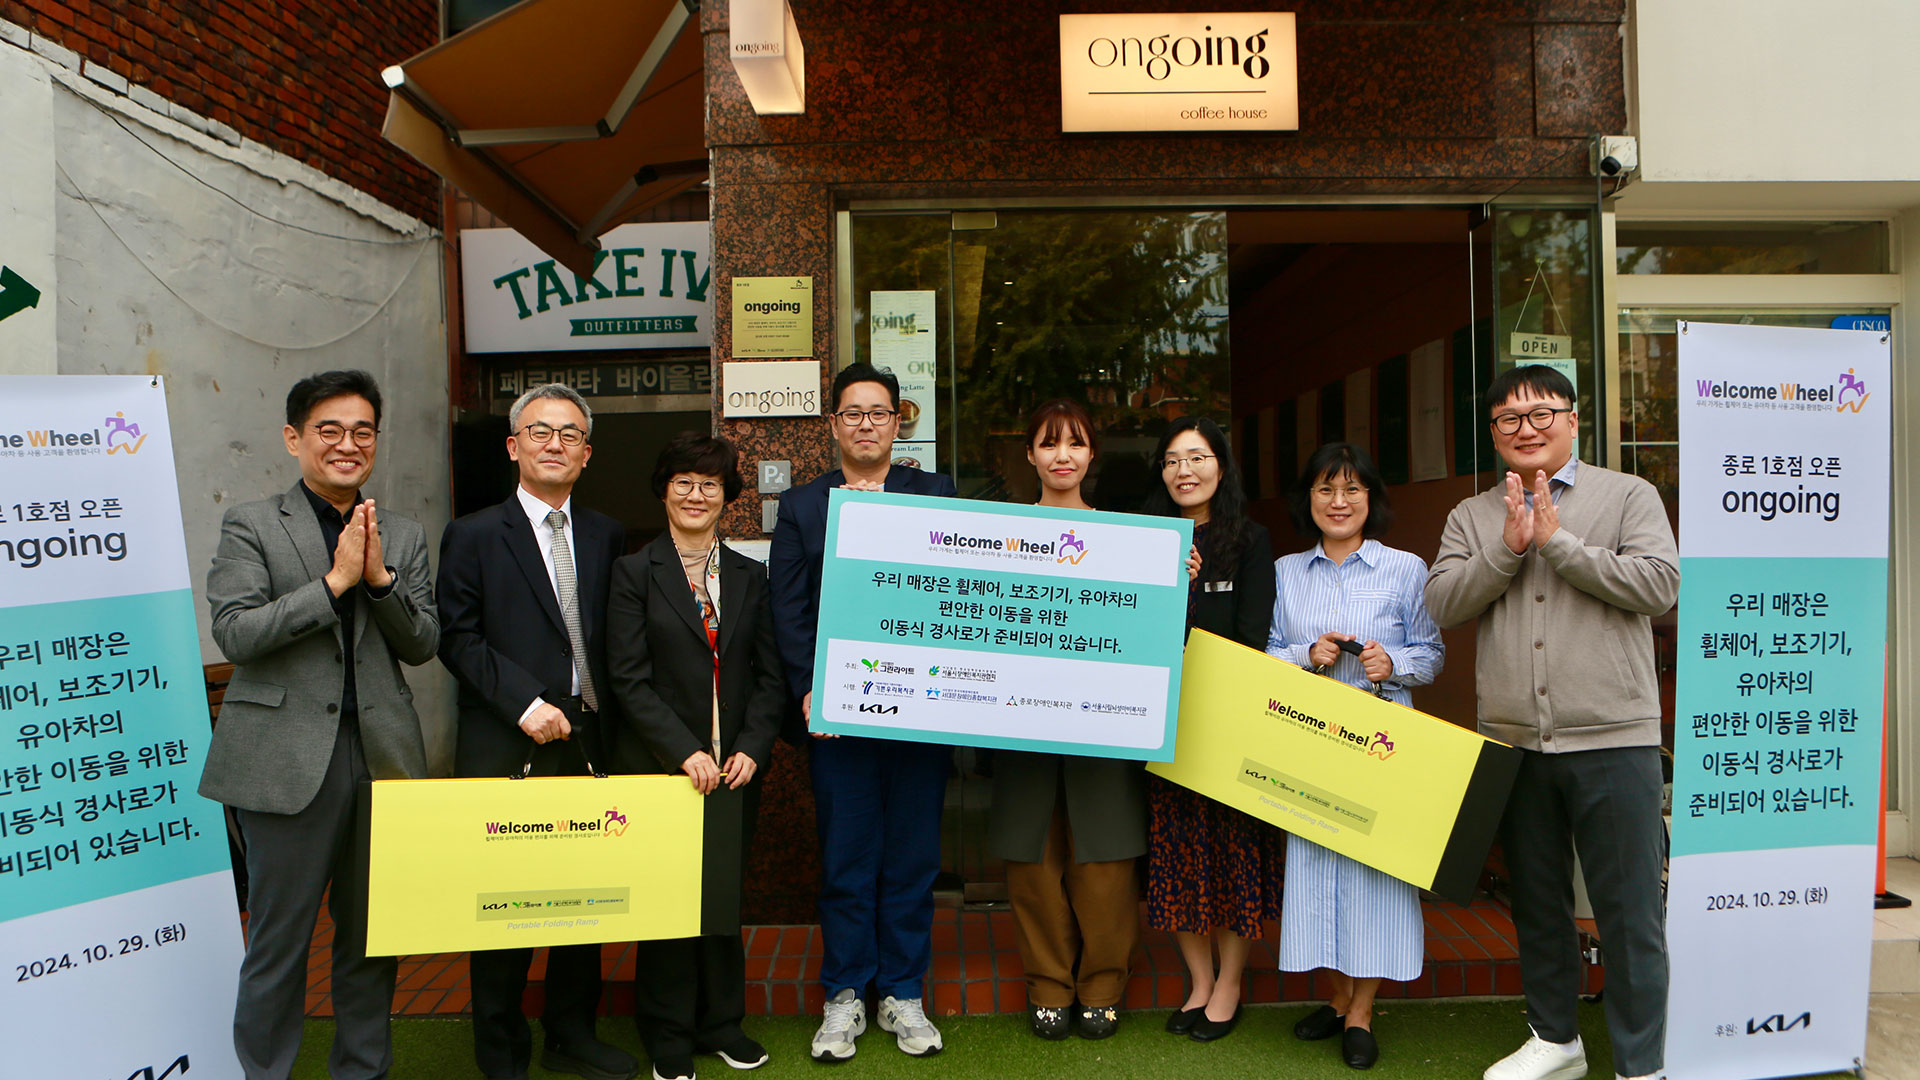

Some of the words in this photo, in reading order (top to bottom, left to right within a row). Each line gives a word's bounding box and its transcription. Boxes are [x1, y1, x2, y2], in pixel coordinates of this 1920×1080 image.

[736, 41, 779, 54] ongoing
[1088, 25, 1270, 80] ongoing
[1180, 106, 1224, 120] coffee
[1229, 106, 1268, 119] house
[493, 247, 645, 320] TAKE
[744, 300, 800, 314] ongoing
[584, 319, 683, 332] OUTFITTERS
[1522, 340, 1558, 354] OPEN
[728, 386, 816, 414] ongoing
[1696, 379, 1778, 400] Welcome
[1780, 383, 1834, 402] Wheel
[26, 428, 101, 448] Wheel
[764, 465, 778, 484] P
[1722, 454, 1756, 476] 종로
[1761, 456, 1803, 478] 1호점
[1808, 456, 1842, 478] 오픈
[12, 500, 70, 522] 1호점
[79, 498, 123, 519] 오픈
[1722, 484, 1840, 522] ongoing
[929, 530, 1003, 550] Welcome
[1006, 537, 1055, 555] Wheel
[872, 570, 902, 590] 우리
[906, 574, 952, 594] 매장은
[956, 577, 1005, 598] 휠체어,
[1008, 584, 1074, 605] 보조기기,
[1078, 588, 1138, 609] 유아차의
[938, 600, 984, 620] 편안한
[988, 604, 1034, 624] 이동을
[1037, 608, 1068, 628] 위한
[1726, 592, 1765, 618] 우리
[1772, 592, 1829, 618] 매장은
[52, 631, 130, 662] 매장은
[880, 618, 924, 638] 이동식
[929, 622, 990, 644] 경사로가
[993, 628, 1053, 649] 준비되어
[1058, 632, 1122, 654] 있습니다.
[1700, 632, 1764, 659] 휠체어,
[1770, 630, 1852, 657] 보조기기,
[58, 666, 168, 702] 보조기기,
[880, 665, 915, 675] 그린라이트
[1736, 670, 1813, 697] 유아차의
[1019, 698, 1073, 710] 종로장애인복지관
[16, 710, 124, 750] 유아차의
[1268, 698, 1326, 730] Welcome
[1328, 721, 1370, 747] Wheel
[1692, 711, 1750, 738] 편안한
[1756, 710, 1812, 736] 이동을
[1818, 708, 1858, 733] 위한
[51, 750, 130, 783] 이동을
[138, 739, 188, 769] 위한
[1702, 750, 1760, 777] 이동식
[1766, 747, 1844, 775] 경사로가
[74, 780, 178, 822] 경사로가
[1258, 795, 1288, 812] Portable
[1288, 808, 1317, 826] Folding
[1689, 788, 1765, 818] 준비되어
[1772, 785, 1854, 813] 있습니다.
[89, 816, 200, 862] 있습니다.
[486, 822, 554, 834] Welcome
[556, 819, 601, 832] Wheel
[1706, 894, 1749, 911] 2024.
[1753, 892, 1774, 908] 10.
[1778, 890, 1800, 906] 29.
[1804, 886, 1828, 906] (화)
[506, 920, 541, 930] Portable
[543, 919, 574, 928] Folding
[576, 918, 600, 926] Ramp
[16, 953, 78, 982] 2024.
[83, 944, 114, 964] 10.
[118, 934, 149, 956] 29.
[154, 922, 186, 947] (화)
